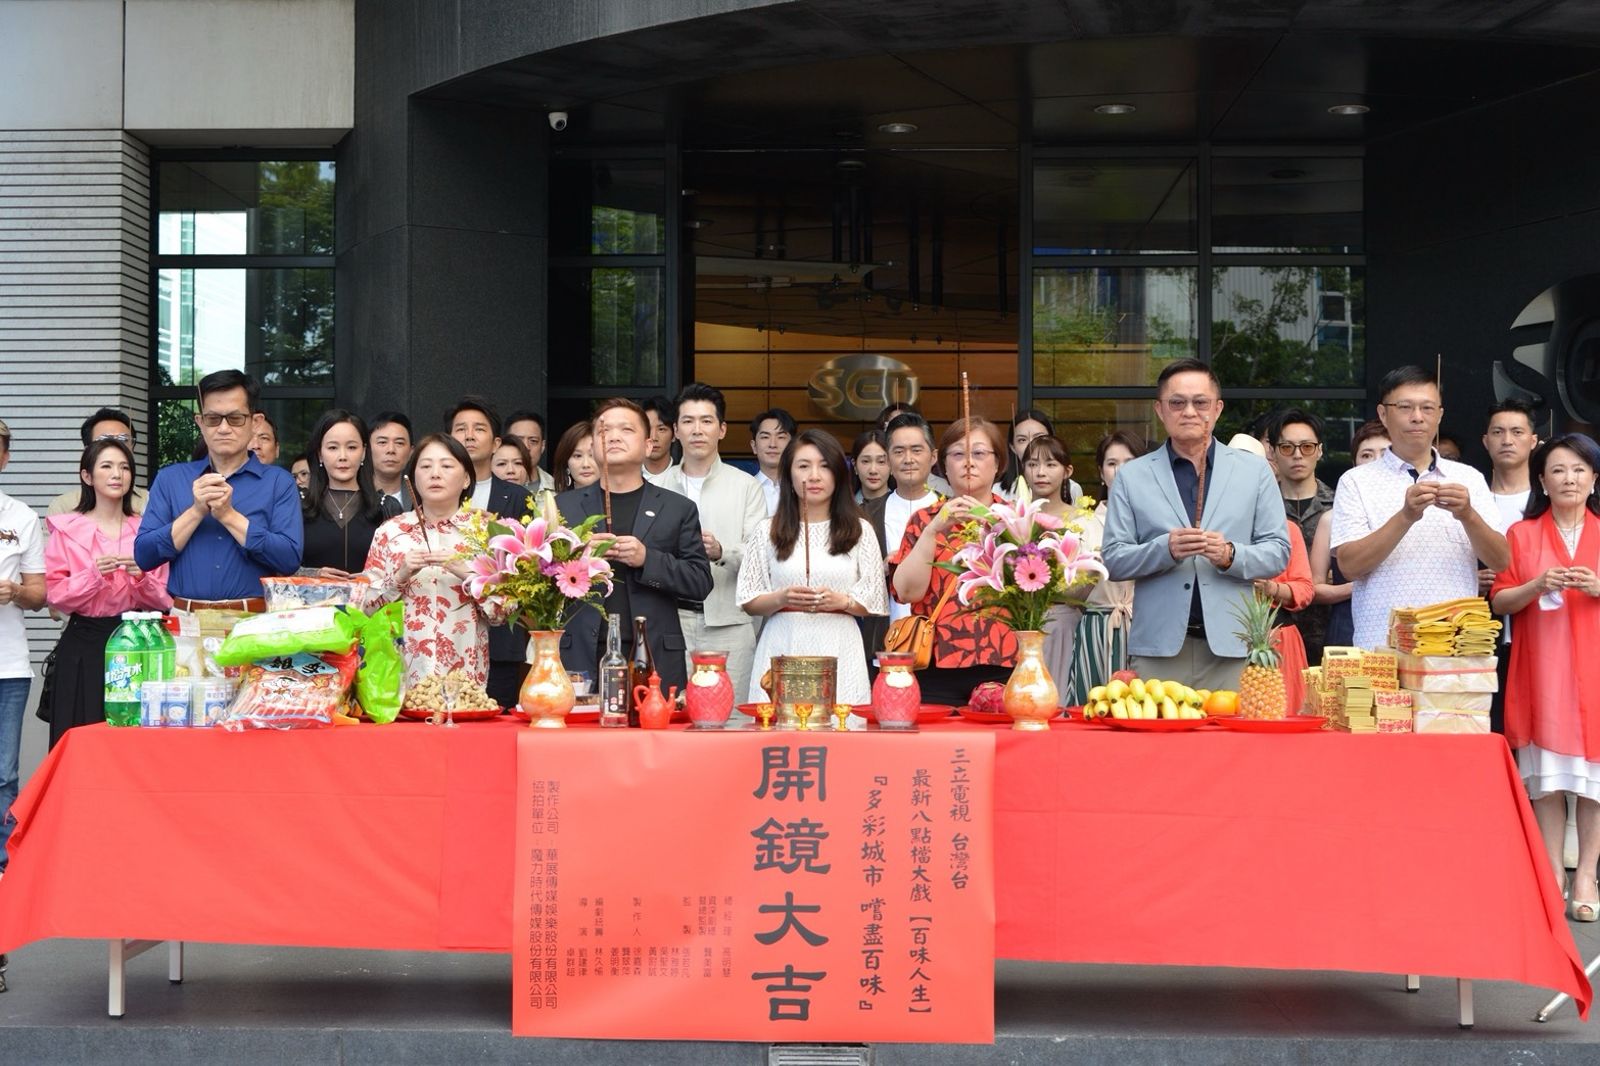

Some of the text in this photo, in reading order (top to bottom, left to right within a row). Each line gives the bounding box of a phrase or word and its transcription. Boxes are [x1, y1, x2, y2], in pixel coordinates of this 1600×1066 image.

[751, 745, 831, 1022] 開鏡大吉
[950, 748, 971, 890] 三立電視 台灣台
